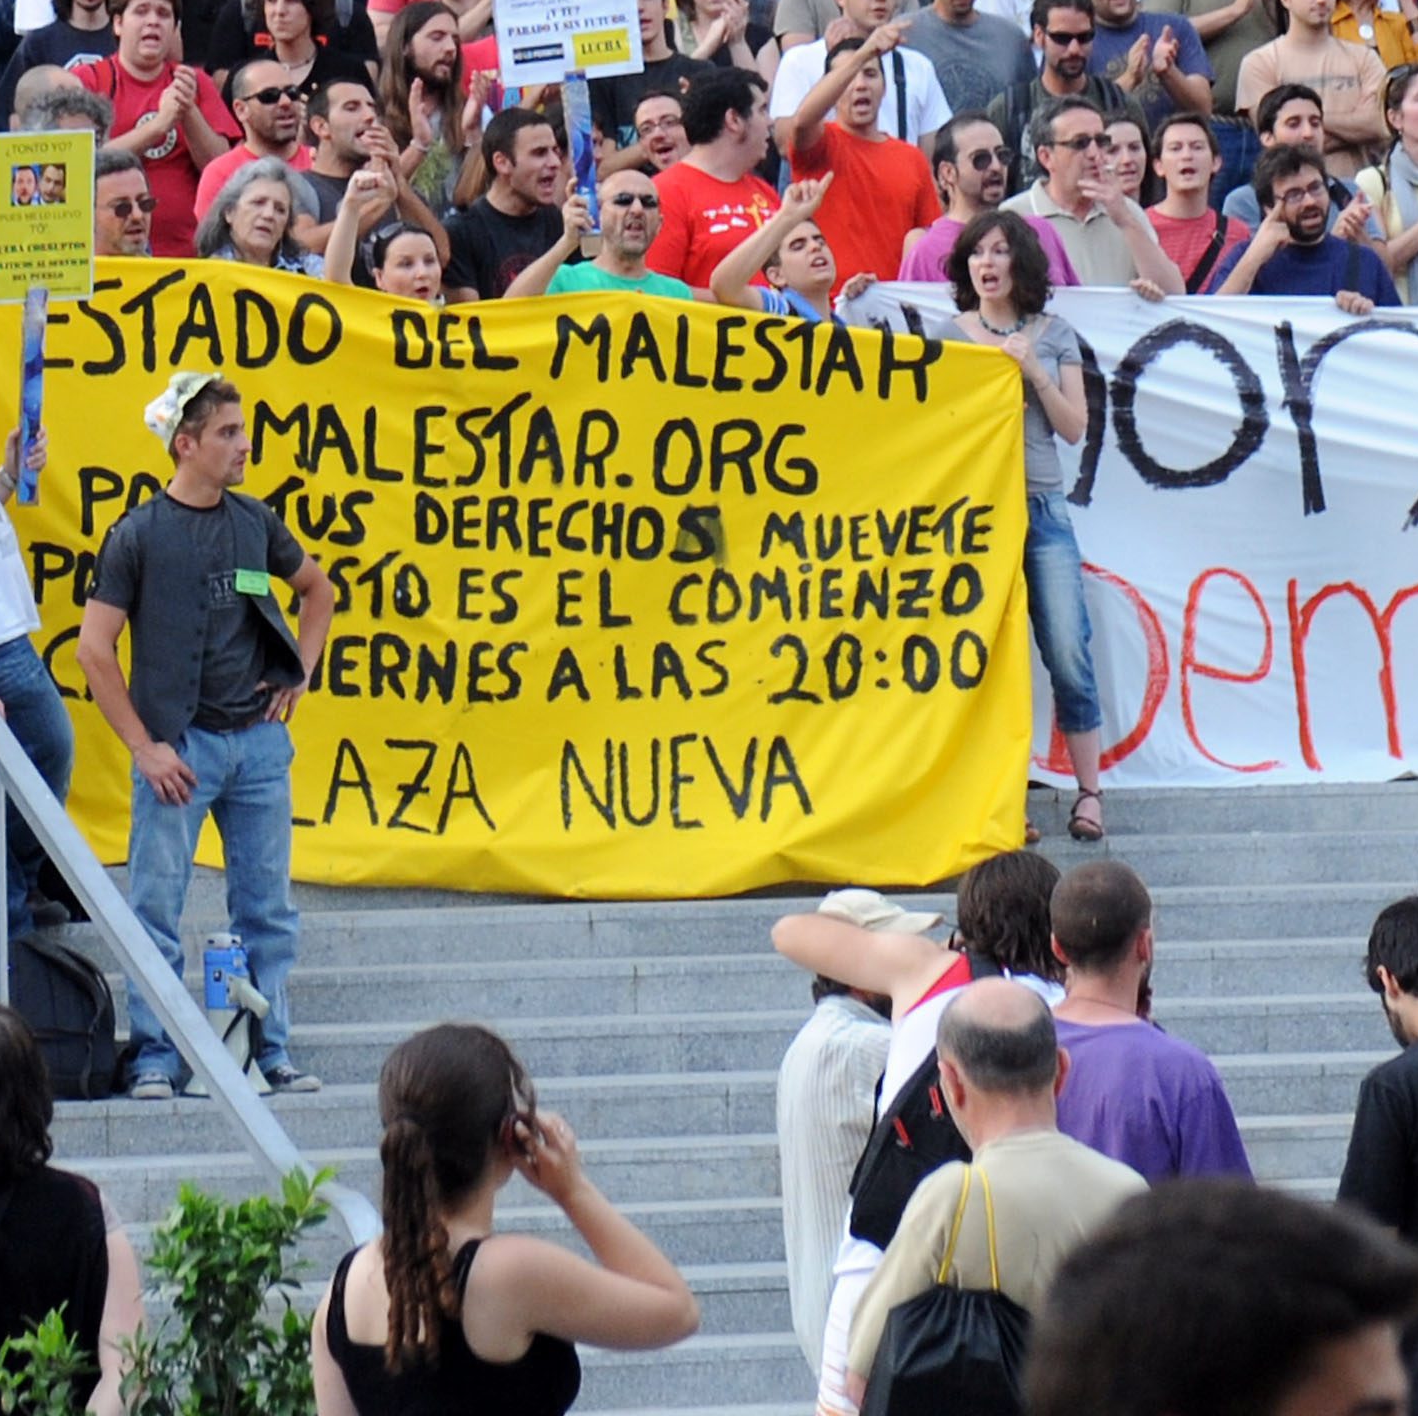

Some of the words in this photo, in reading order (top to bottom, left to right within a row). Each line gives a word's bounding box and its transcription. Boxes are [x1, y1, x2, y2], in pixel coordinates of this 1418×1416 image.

[507, 22, 551, 37] PARADO
[553, 21, 561, 32] Y
[563, 19, 581, 31] SIN
[581, 41, 622, 55] LUCHA
[27, 241, 87, 254] CORRUPTOS
[392, 309, 519, 370] DEL
[414, 490, 722, 565] DERECHOS
[760, 496, 995, 563] MUEVETE
[457, 567, 519, 624] ES
[555, 566, 632, 629] EL
[547, 647, 590, 702] A
[614, 640, 730, 702] LAS
[768, 630, 988, 705] 20:00
[561, 733, 815, 831] NUEVA
